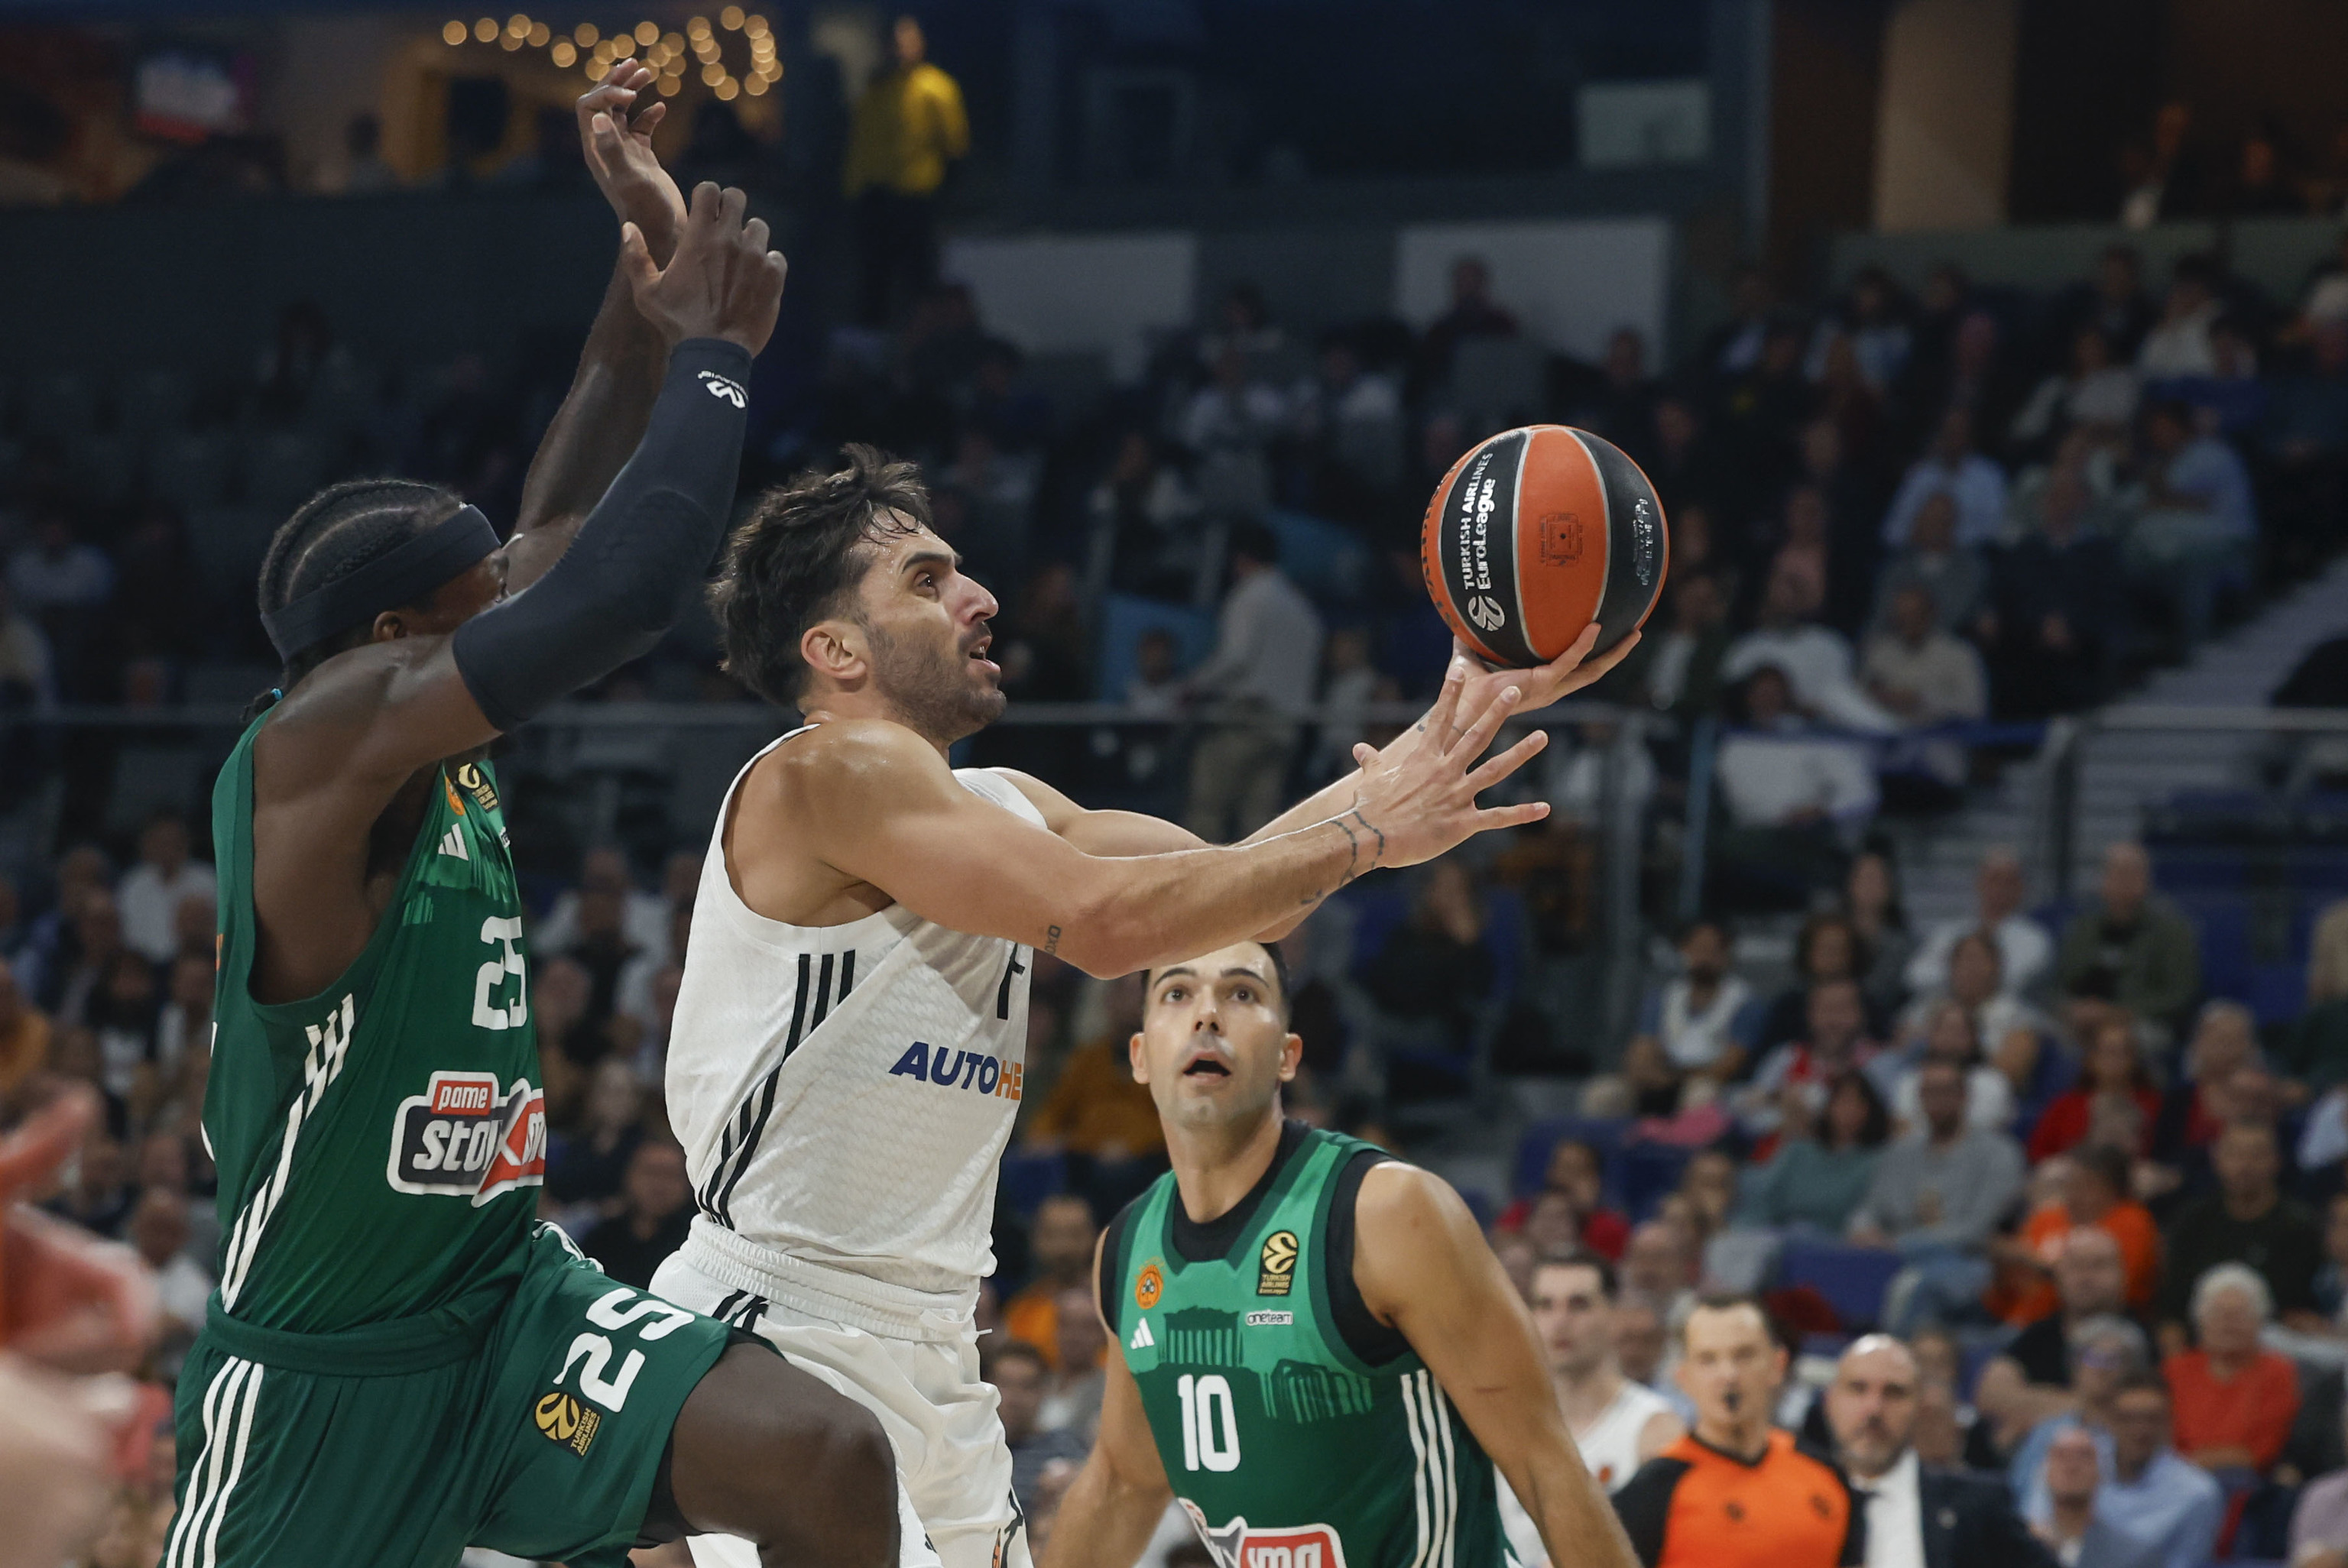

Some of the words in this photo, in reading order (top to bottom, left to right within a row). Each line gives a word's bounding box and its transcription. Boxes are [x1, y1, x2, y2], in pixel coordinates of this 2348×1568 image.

[1462, 453, 1493, 513] AIRLINES
[1460, 517, 1475, 590] TURKISH
[1472, 478, 1496, 589] EuroLeague
[472, 916, 527, 1030] 25
[437, 1086, 489, 1111] pame
[553, 1288, 696, 1413] 25
[570, 1408, 591, 1448] TURKISH
[577, 1411, 597, 1453] AIRLINES
[1178, 1374, 1241, 1472] 10
